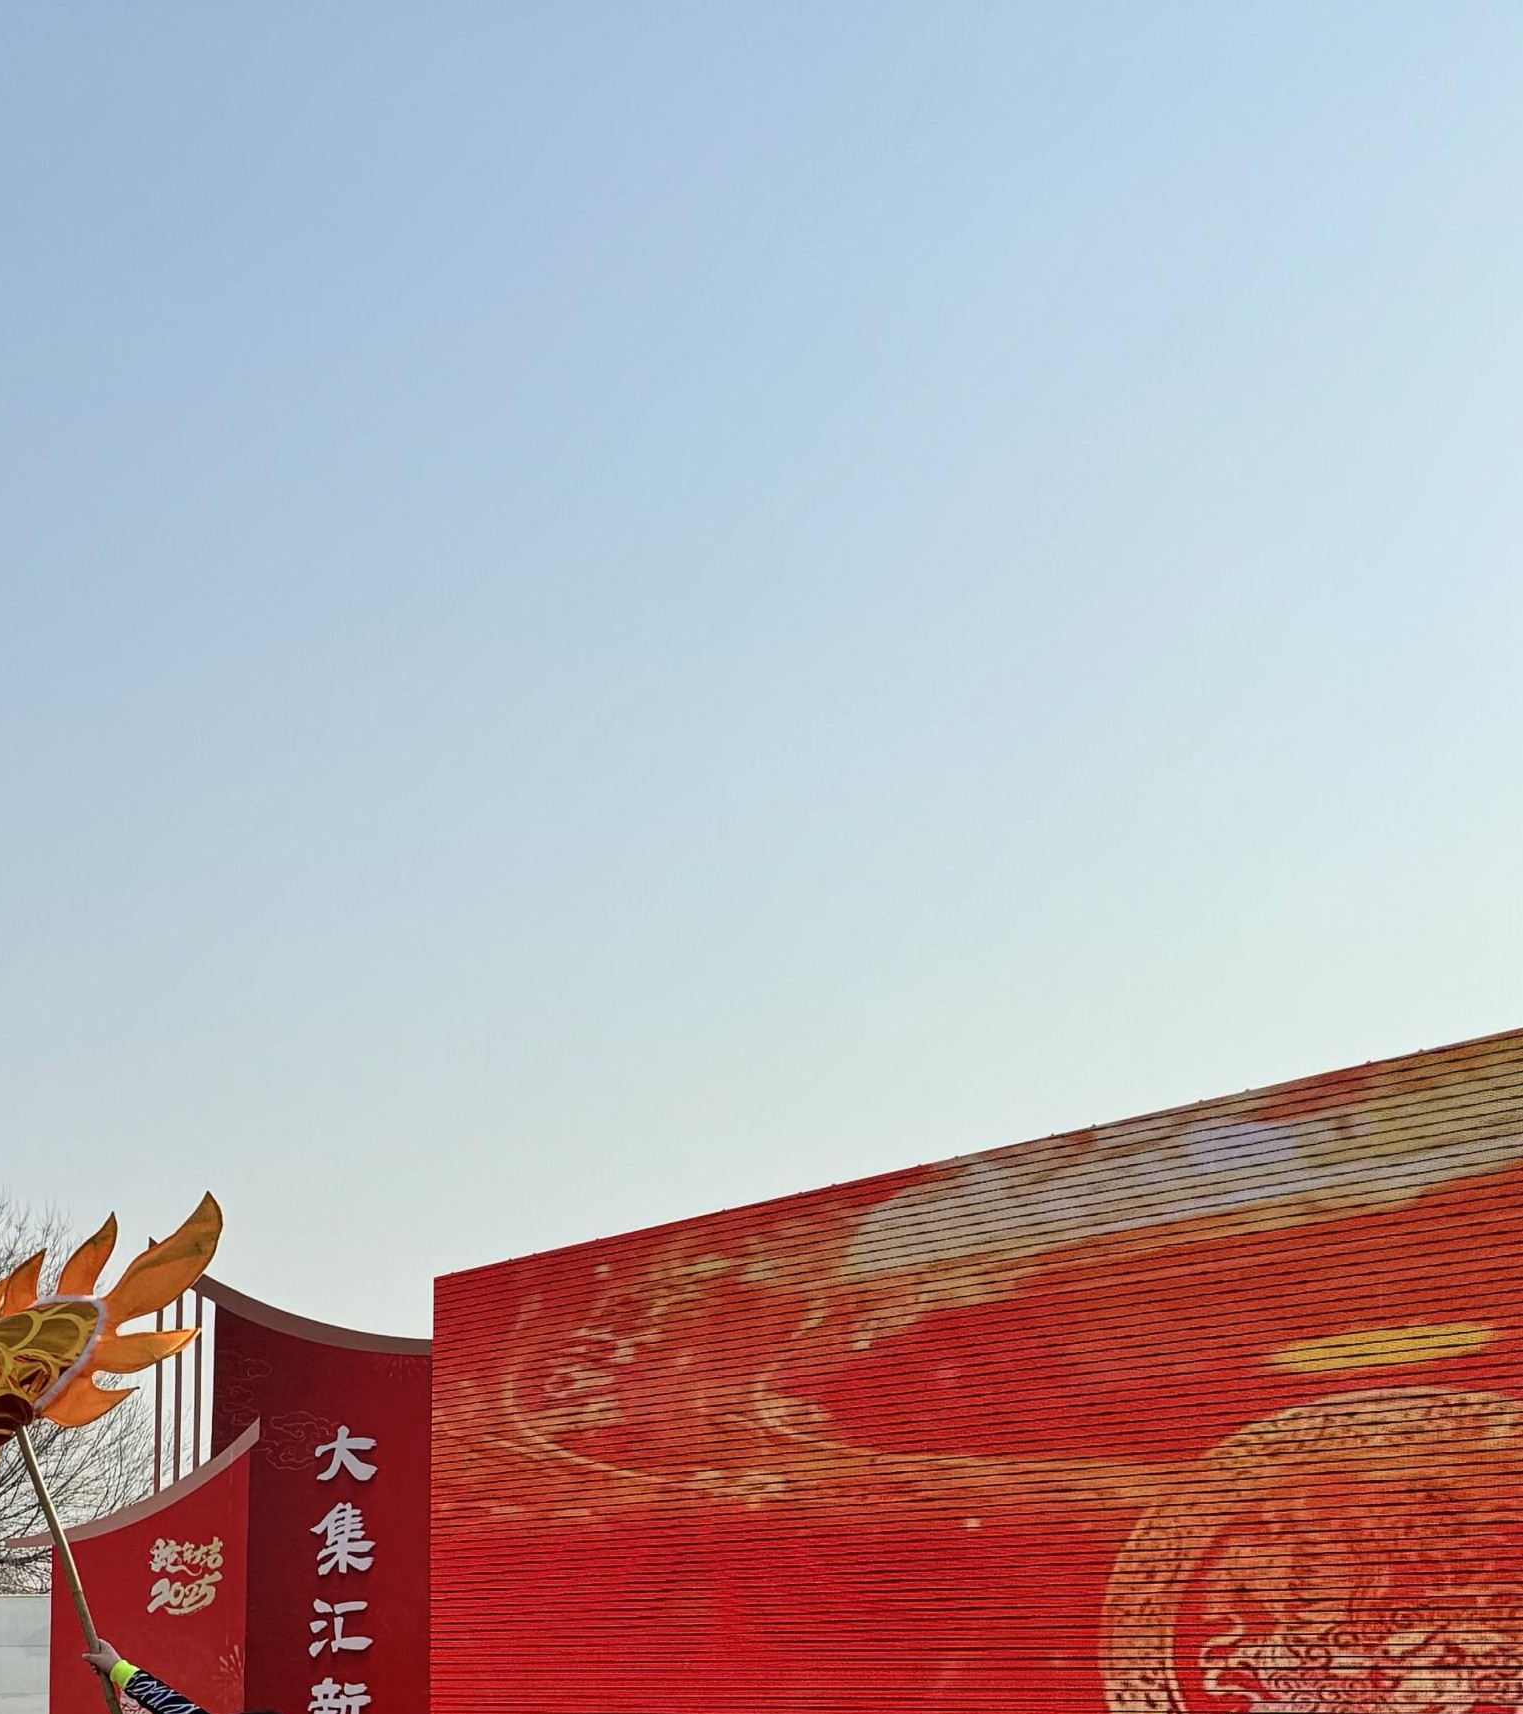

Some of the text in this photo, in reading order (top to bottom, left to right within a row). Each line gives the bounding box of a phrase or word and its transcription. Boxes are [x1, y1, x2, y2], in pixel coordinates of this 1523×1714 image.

[148, 1536, 224, 1577] 蛇年大吉
[146, 1571, 223, 1616] 2025
